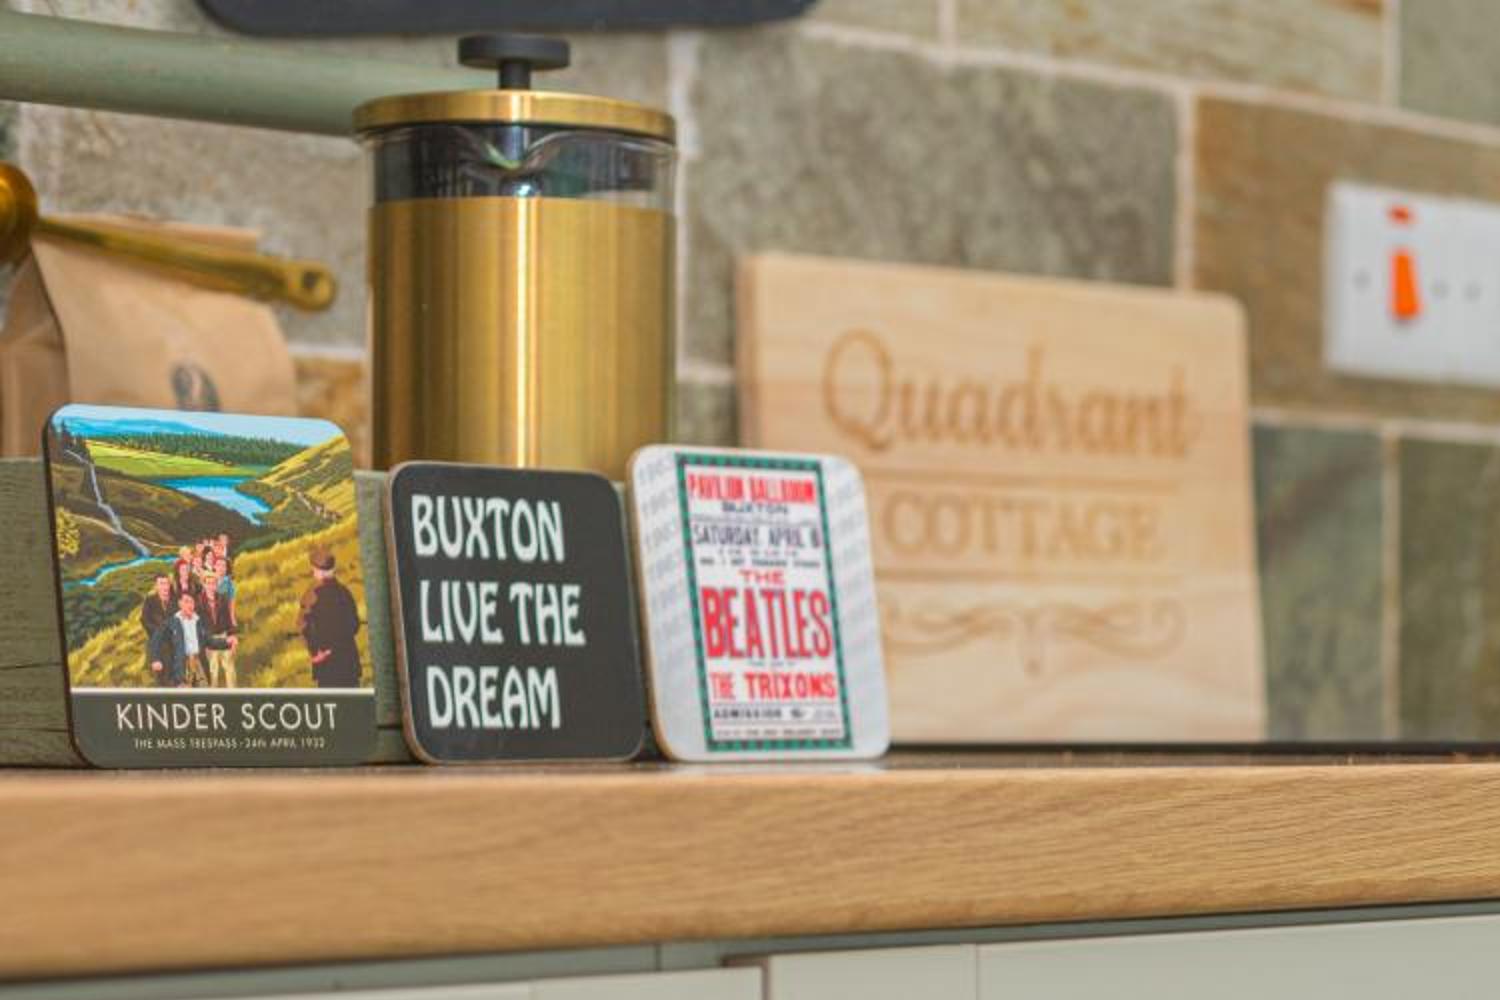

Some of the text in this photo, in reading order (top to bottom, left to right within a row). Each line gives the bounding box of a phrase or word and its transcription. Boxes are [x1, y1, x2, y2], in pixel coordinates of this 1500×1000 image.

[823, 328, 1193, 459] Quadrant
[412, 494, 564, 563] BUXTON
[882, 490, 1167, 564] COTTAGE
[739, 569, 786, 585] THE
[420, 579, 586, 646] LIVE THE
[702, 587, 832, 658] BEATLES
[116, 703, 337, 730] KINDER SCOUT
[426, 665, 561, 729] DREAM
[744, 672, 837, 699] TRIXONS
[135, 738, 153, 749] THE
[157, 738, 185, 749] MASS
